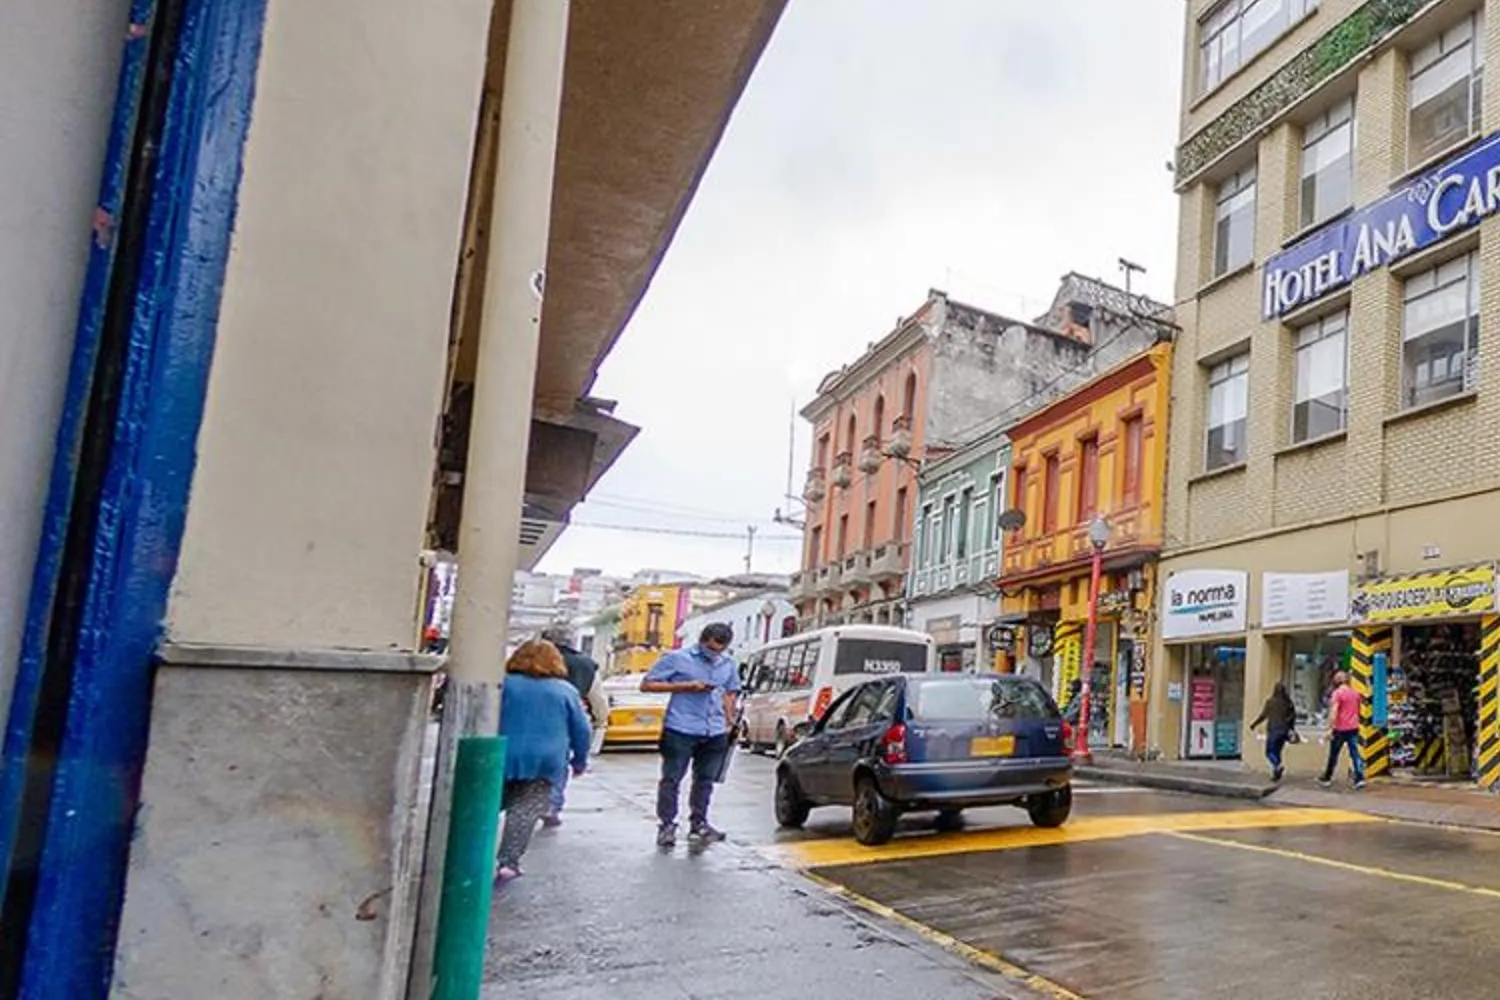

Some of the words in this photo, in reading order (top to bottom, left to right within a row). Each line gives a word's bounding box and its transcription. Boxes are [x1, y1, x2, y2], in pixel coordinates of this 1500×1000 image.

[1264, 251, 1344, 316] HOTEL
[1351, 222, 1416, 275] ANA
[1171, 590, 1183, 606] la
[1187, 584, 1235, 604] norma
